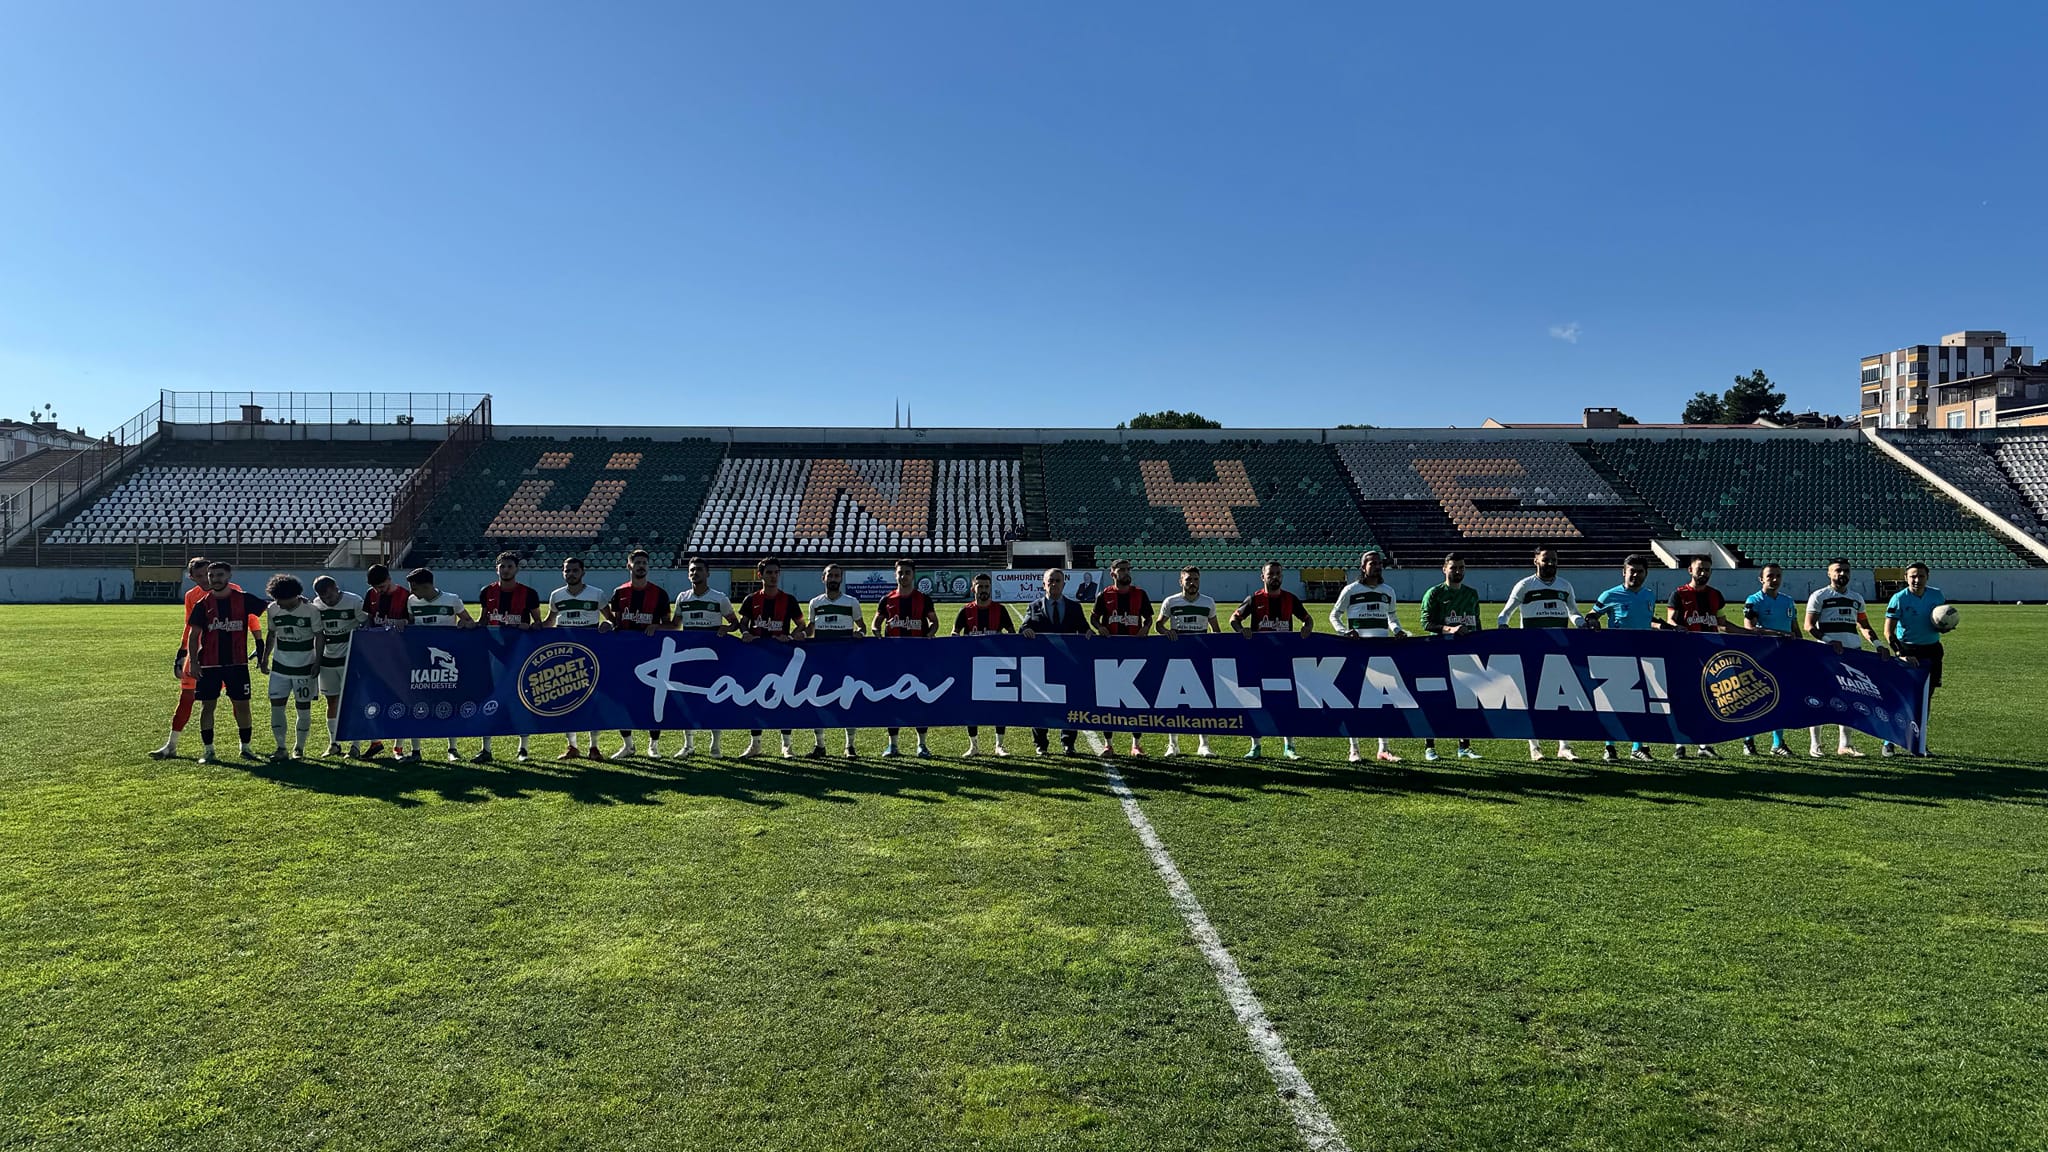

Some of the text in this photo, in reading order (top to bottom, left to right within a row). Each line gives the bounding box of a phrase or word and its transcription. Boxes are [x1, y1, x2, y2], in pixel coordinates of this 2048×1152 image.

[532, 647, 574, 667] KADINA
[411, 668, 459, 683] KADES
[634, 636, 1671, 723] Kadına EL KAL-KA-MAZ!
[243, 683, 250, 696] 5
[297, 686, 310, 698] 10
